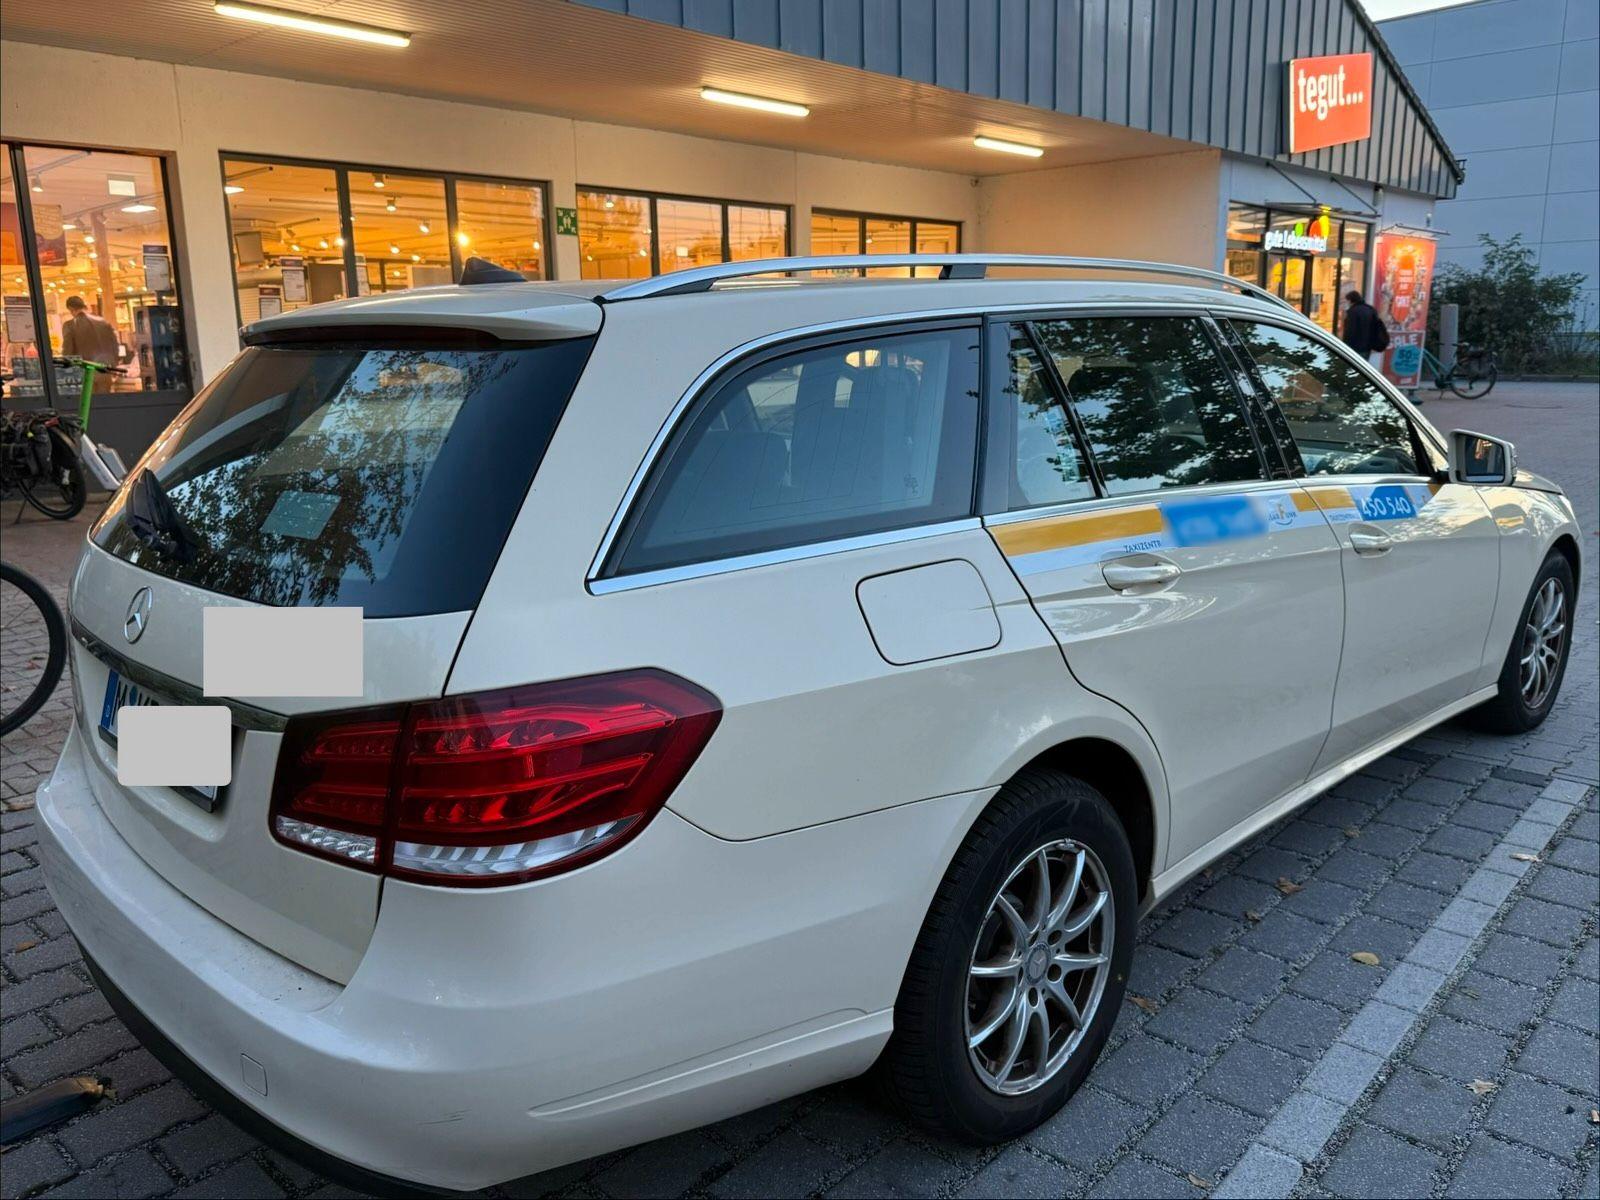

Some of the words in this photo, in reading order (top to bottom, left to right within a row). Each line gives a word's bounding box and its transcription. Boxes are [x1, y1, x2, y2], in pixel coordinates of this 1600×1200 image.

[1298, 64, 1363, 121] tegut...
[1361, 496, 1387, 517] 450
[1387, 496, 1411, 515] 540
